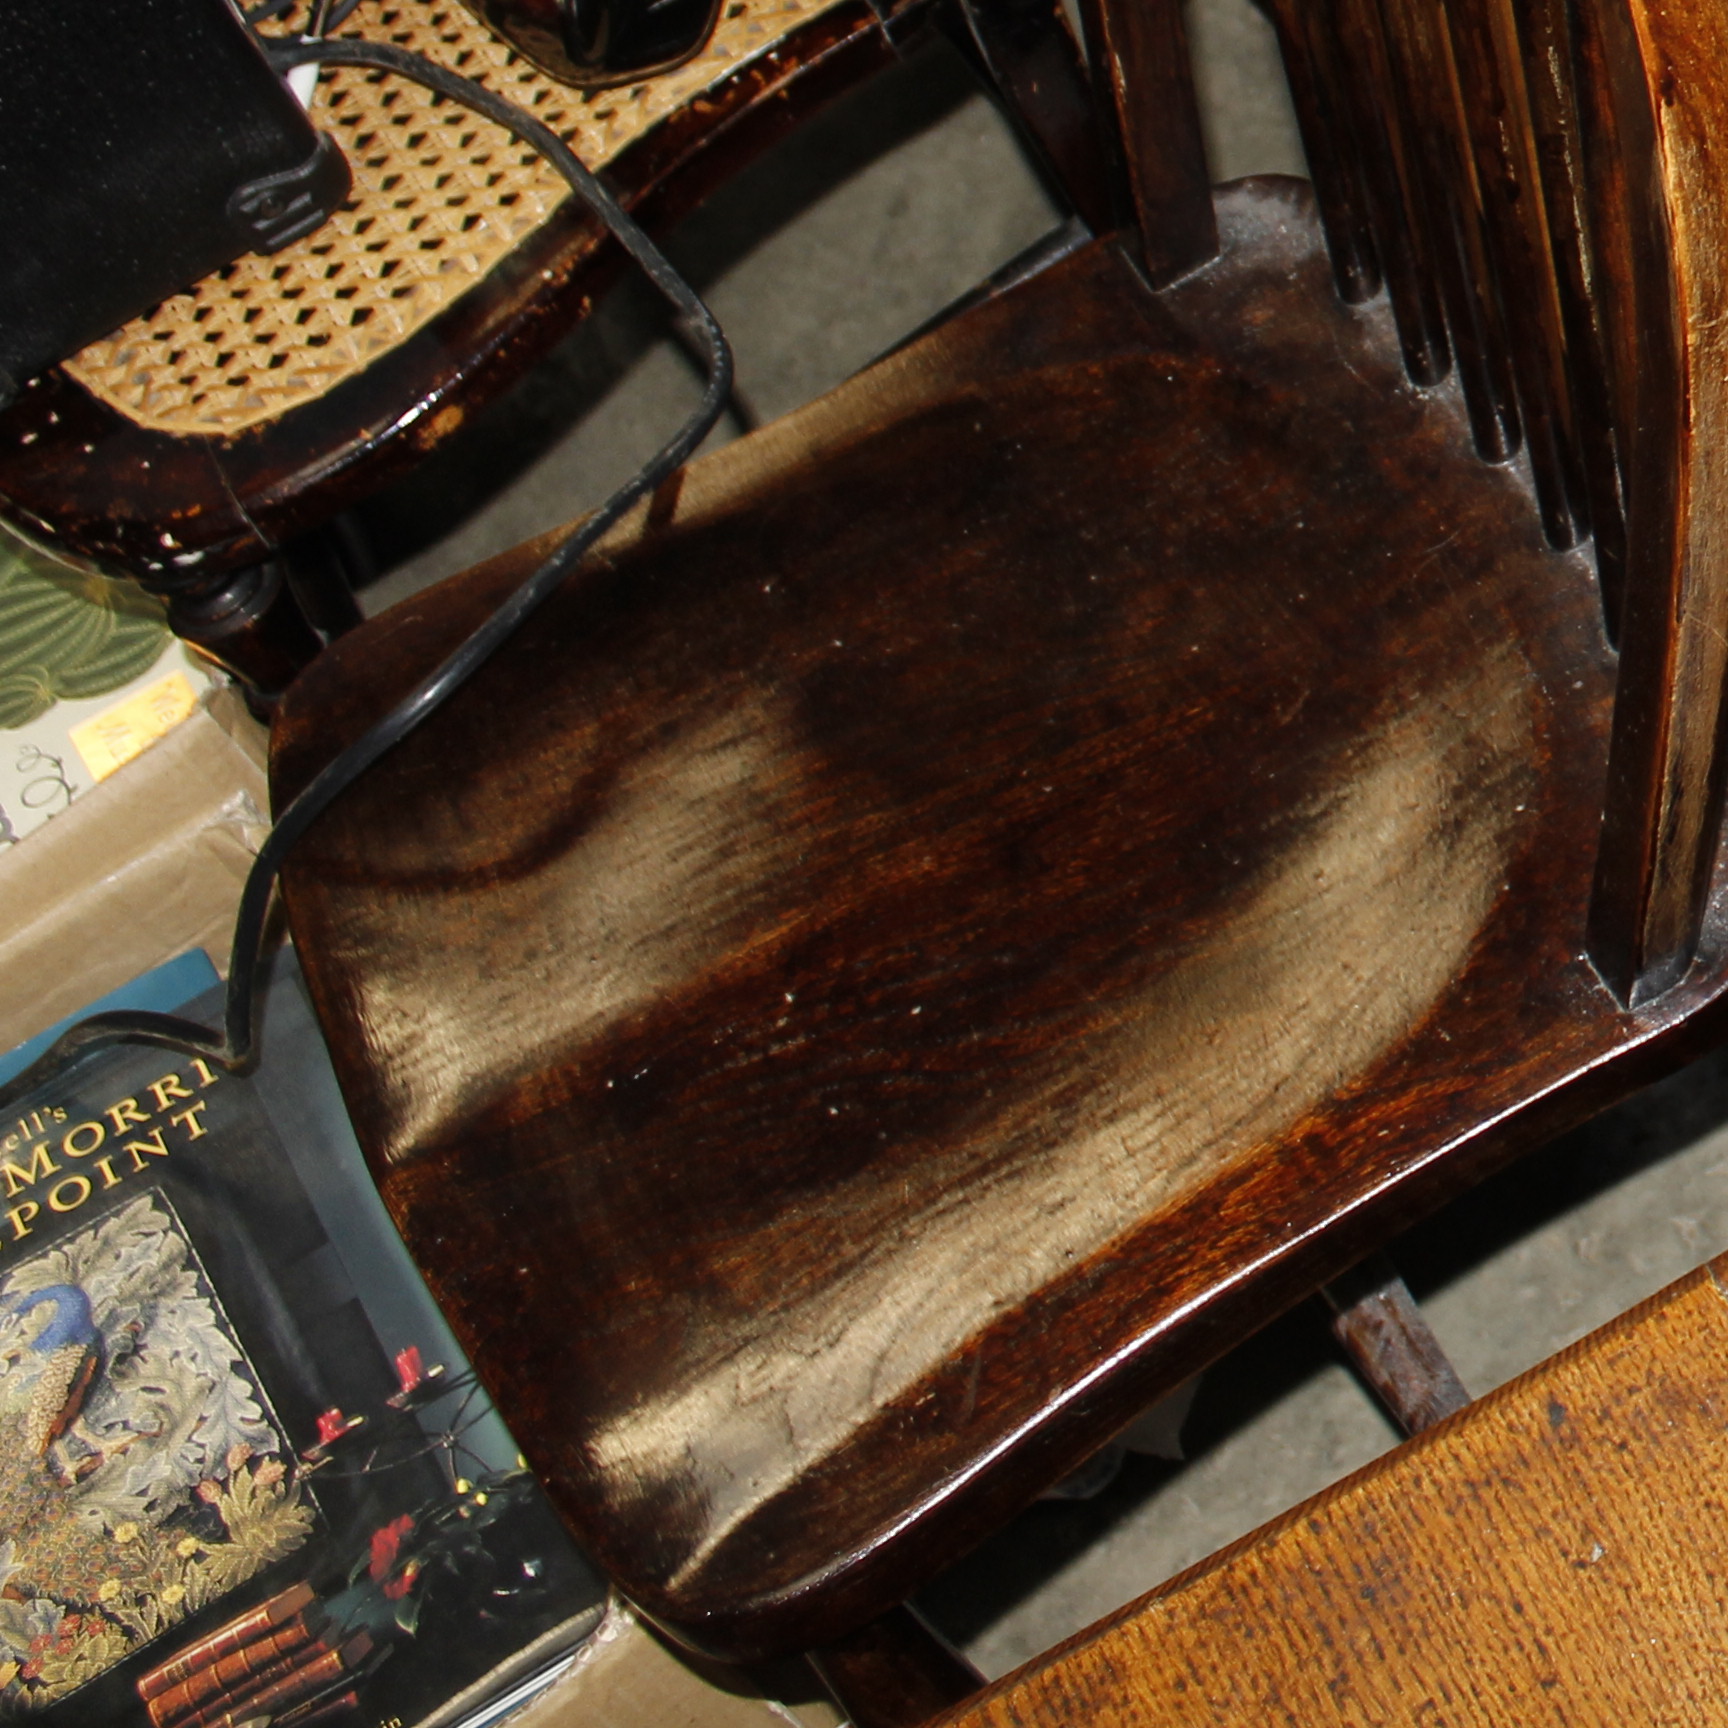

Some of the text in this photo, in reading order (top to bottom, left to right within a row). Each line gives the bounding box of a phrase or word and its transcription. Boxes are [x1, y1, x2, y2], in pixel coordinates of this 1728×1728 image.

[0, 1057, 219, 1198] MORRI
[0, 1100, 209, 1246] POINT
[2, 1106, 68, 1152] ell's
